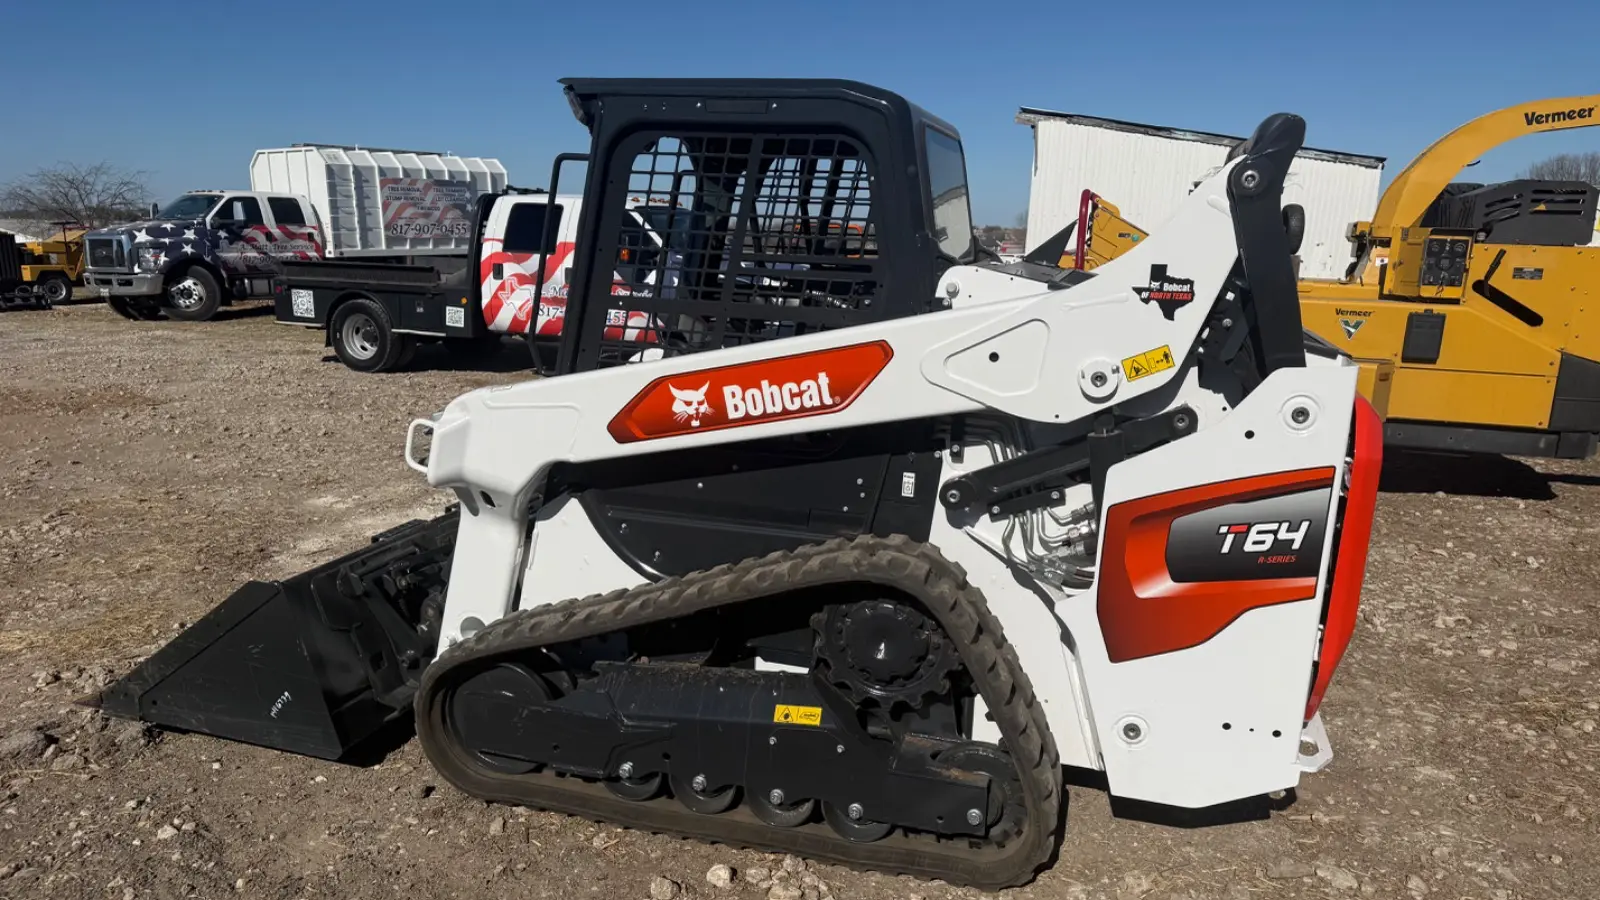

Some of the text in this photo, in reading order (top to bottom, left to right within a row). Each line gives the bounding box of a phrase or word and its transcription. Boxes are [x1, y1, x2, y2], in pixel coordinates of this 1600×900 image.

[1524, 107, 1595, 126] Vermeer
[391, 223, 467, 236] 817-907-0455
[272, 243, 288, 251] Tree
[1163, 283, 1191, 292] Bobcat
[1141, 291, 1193, 300] OF NORTH TEXAS
[1335, 308, 1372, 317] Vermeer
[722, 372, 834, 419] Bobcat
[1218, 520, 1310, 554] T64
[1257, 555, 1297, 564] R-SERIES
